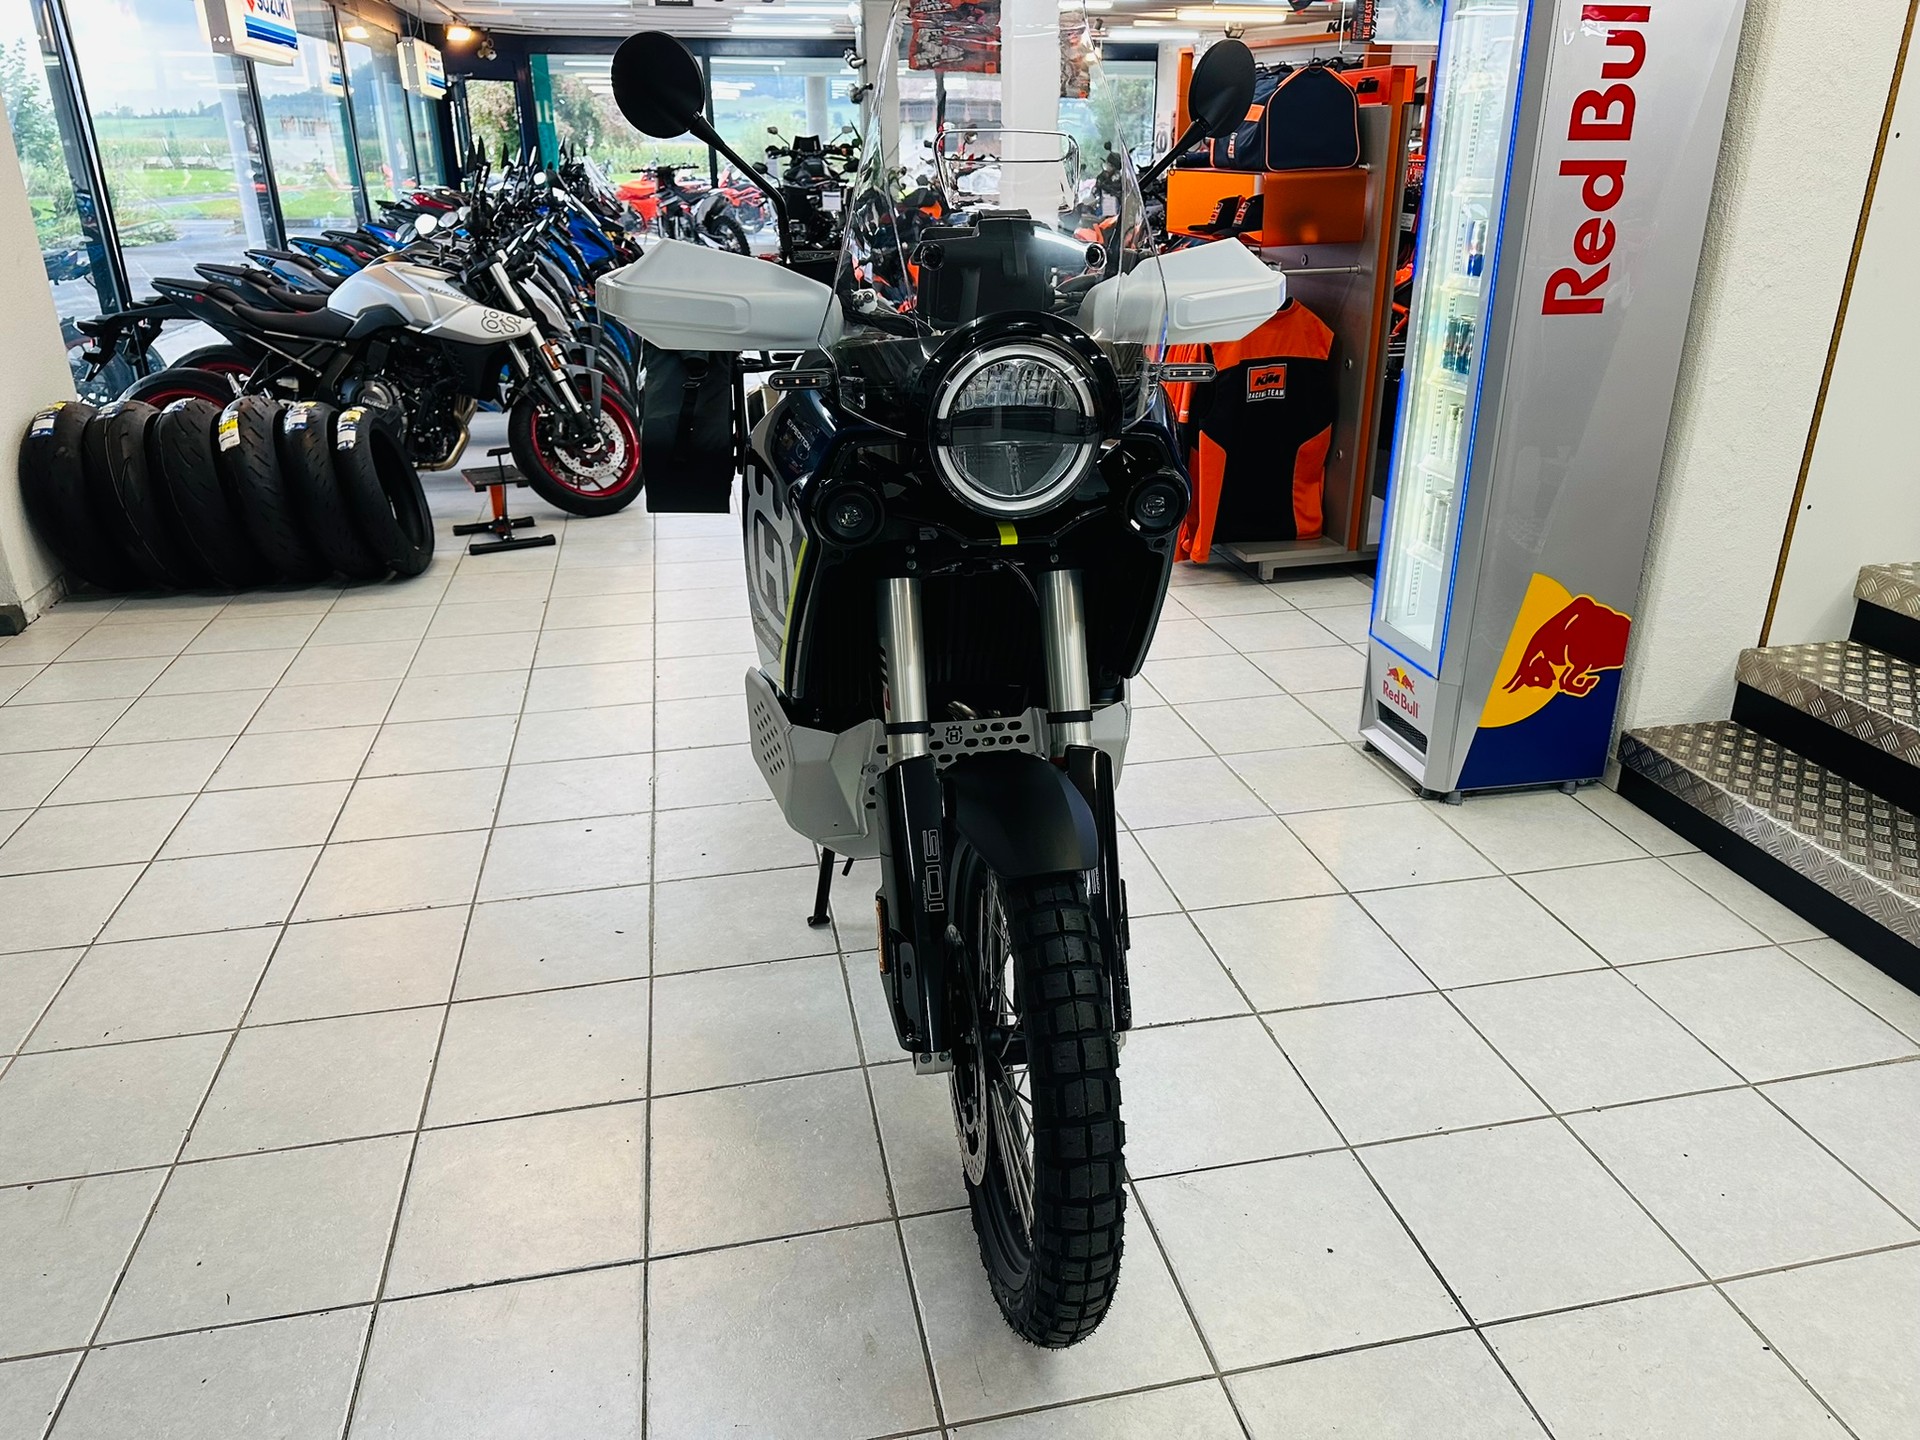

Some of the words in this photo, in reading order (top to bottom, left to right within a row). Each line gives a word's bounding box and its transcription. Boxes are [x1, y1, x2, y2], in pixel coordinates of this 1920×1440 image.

[1363, 0, 1374, 23] BEAST
[1362, 25, 1371, 39] THE
[1567, 4, 1652, 141] Bul
[1541, 159, 1628, 315] Red
[1254, 371, 1282, 387] KTM
[1267, 388, 1285, 397] TEAM
[1382, 680, 1400, 706] Red
[1400, 692, 1419, 719] Bull
